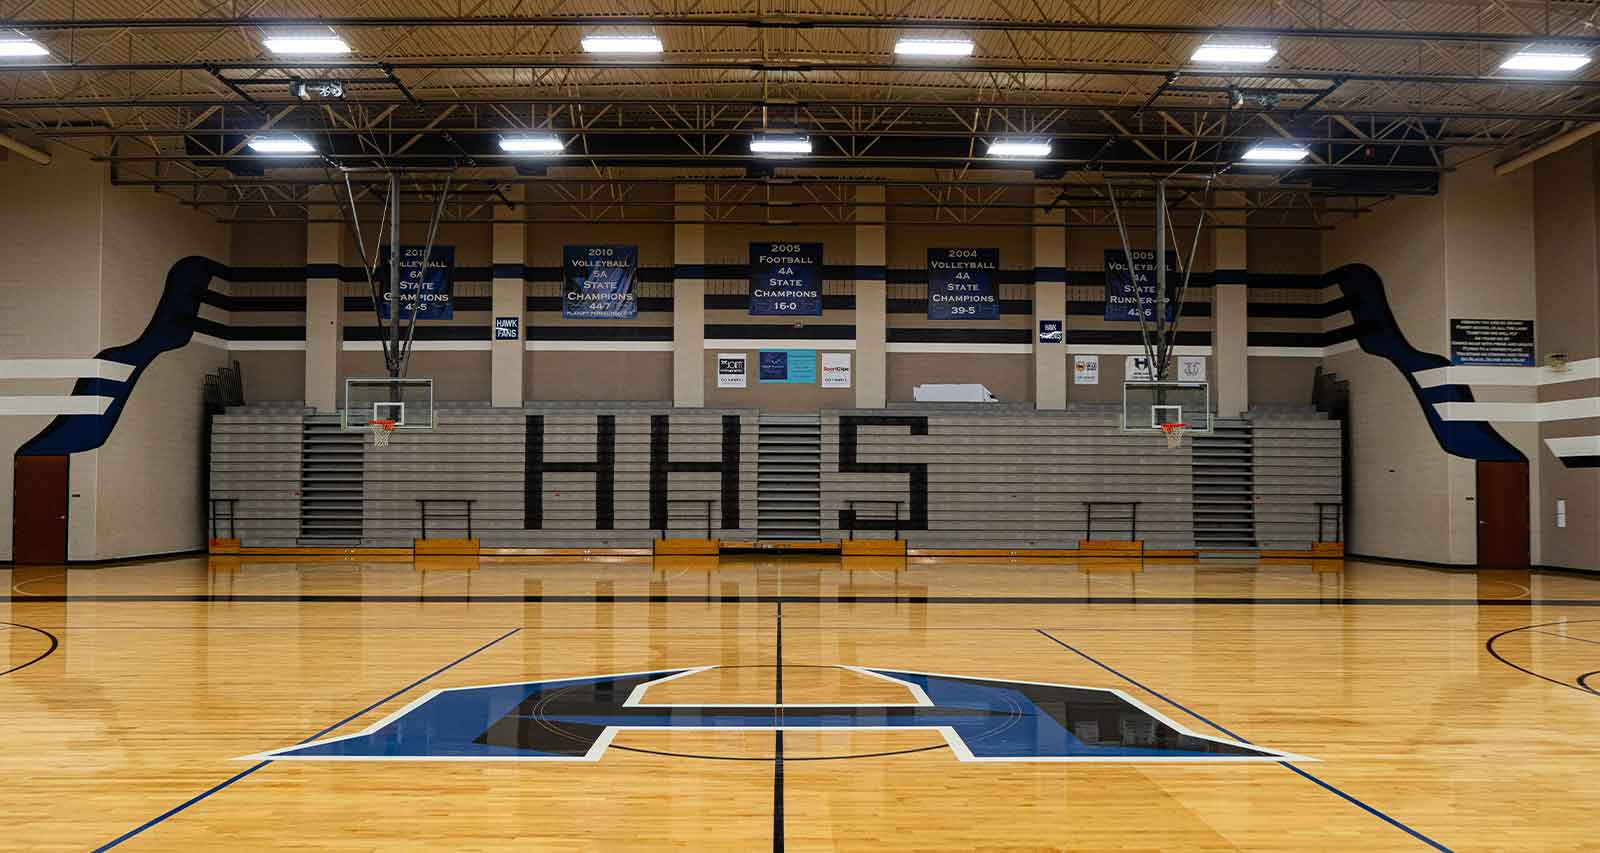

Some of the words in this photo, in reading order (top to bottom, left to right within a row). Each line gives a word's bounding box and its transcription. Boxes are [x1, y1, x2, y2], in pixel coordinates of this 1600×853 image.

[588, 248, 614, 256] 2010
[771, 244, 801, 253] 2005
[948, 250, 977, 258] 2004
[571, 259, 630, 267] VOLLEYBALL
[759, 255, 813, 264] FOOTBALL
[931, 260, 996, 269] VOLLEYBALL
[593, 270, 608, 278] 5A
[778, 267, 794, 275] 4A
[955, 272, 970, 280] 4A
[583, 280, 617, 289] STATE
[769, 278, 803, 287] STATE
[947, 283, 980, 291] STATE
[383, 292, 449, 302] CAMPIONS
[567, 291, 634, 301] CHAMPIONS
[754, 289, 817, 298] CHAMPIONS
[932, 294, 994, 302] CHAMPIONS
[774, 302, 797, 310] 16-0
[951, 306, 976, 315] 39-5
[496, 319, 518, 328] HAWK
